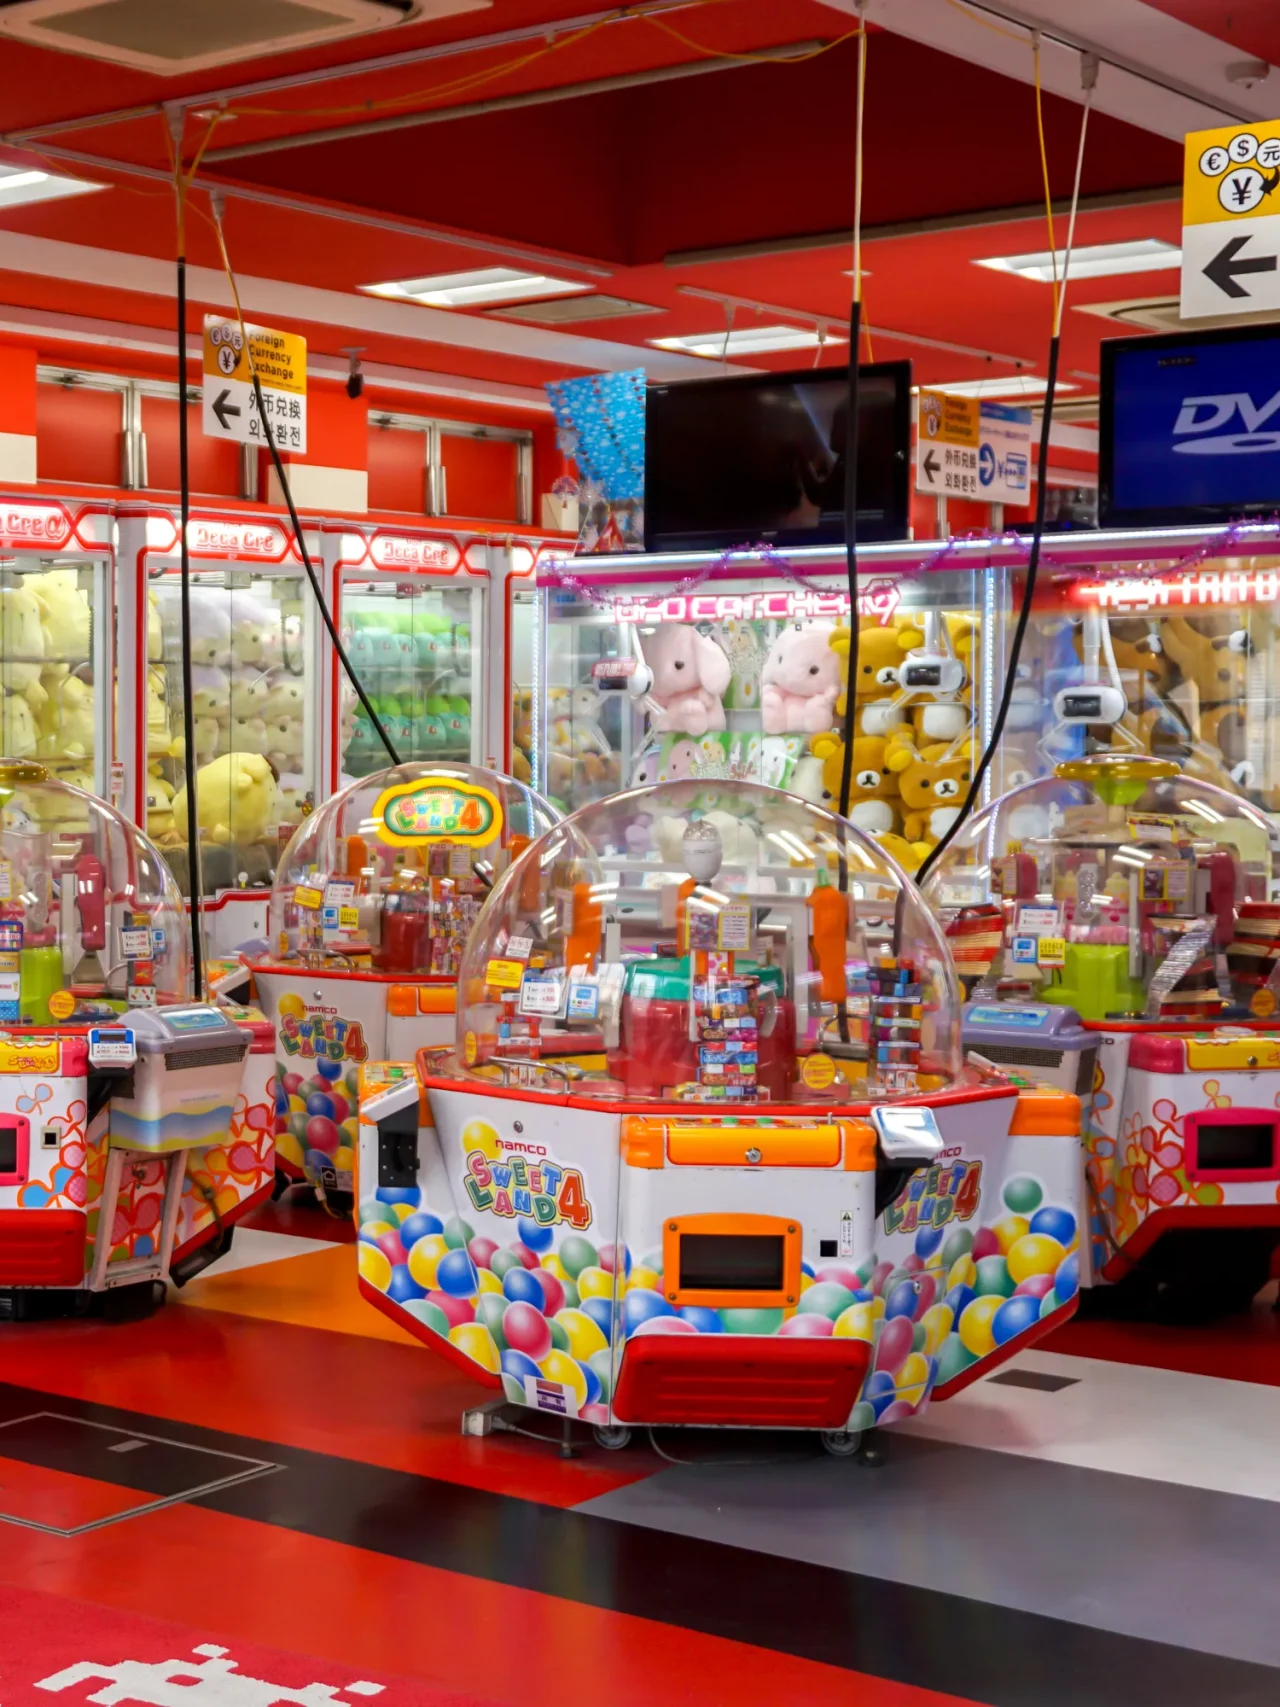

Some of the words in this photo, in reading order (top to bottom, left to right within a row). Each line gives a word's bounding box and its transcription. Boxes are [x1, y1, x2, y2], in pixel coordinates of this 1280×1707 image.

[1232, 176, 1253, 205] ¥
[300, 1003, 339, 1015] namco
[282, 1014, 349, 1043] SWEET
[279, 1031, 346, 1063] LAND
[495, 1139, 548, 1156] namco
[468, 1151, 563, 1198] SWEET
[464, 1175, 558, 1225] LAND
[557, 1169, 592, 1230] 4
